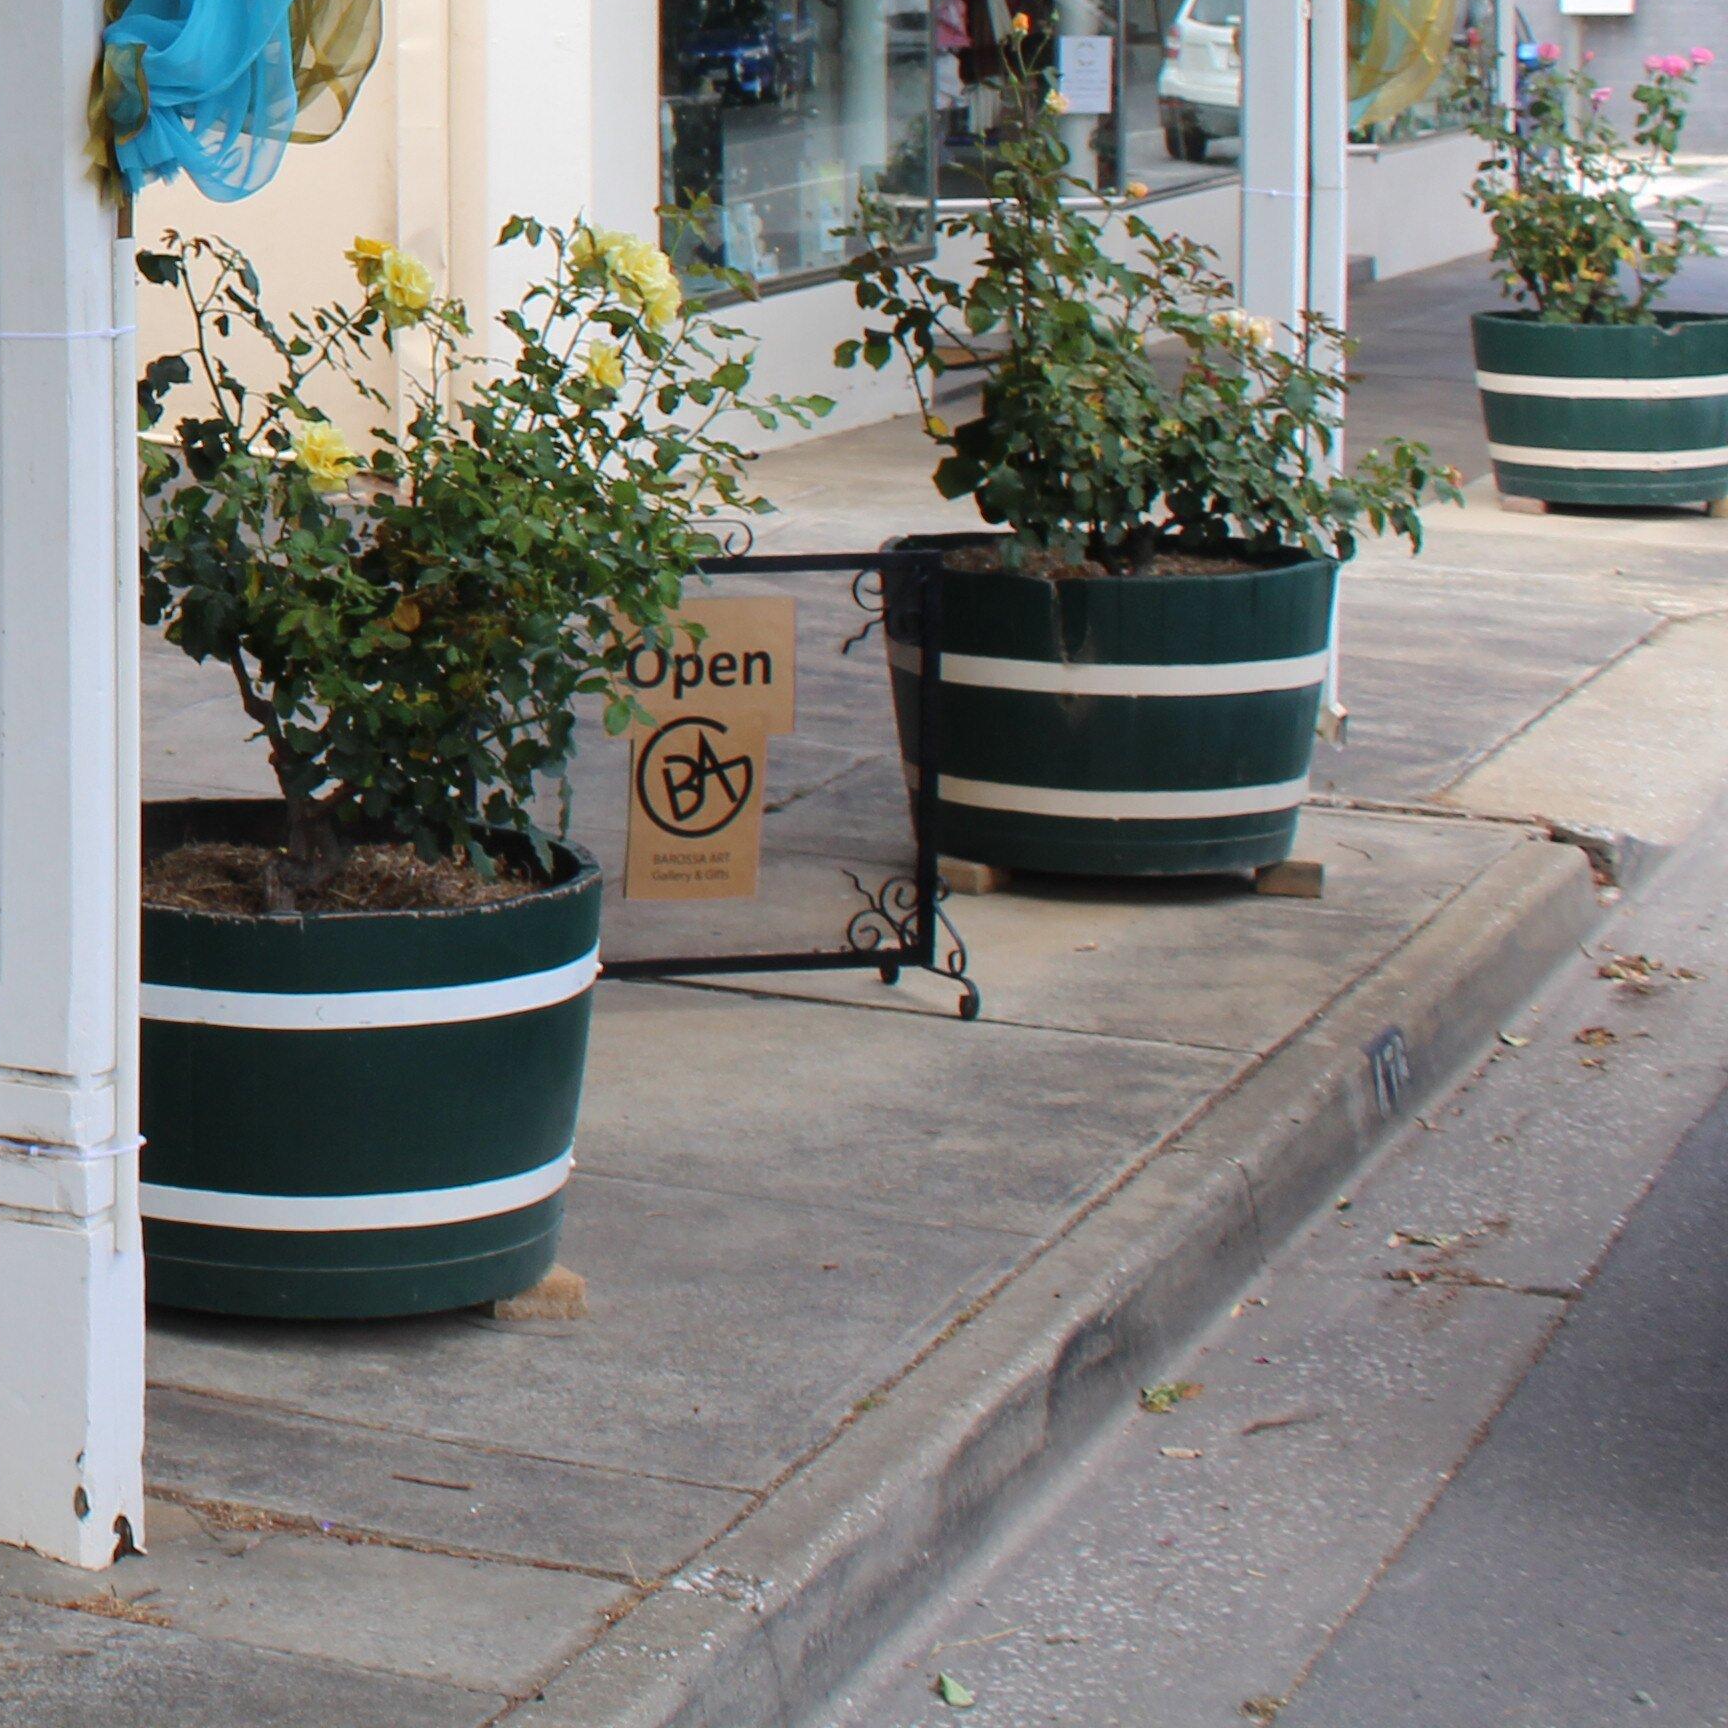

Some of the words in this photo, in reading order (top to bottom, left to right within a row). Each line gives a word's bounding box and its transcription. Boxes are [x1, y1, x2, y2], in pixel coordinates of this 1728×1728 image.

[625, 642, 772, 700] Open
[653, 853, 707, 865] BAROSSA
[709, 851, 731, 864] ART
[651, 869, 692, 883] Gallery
[704, 868, 730, 881] Gifts
